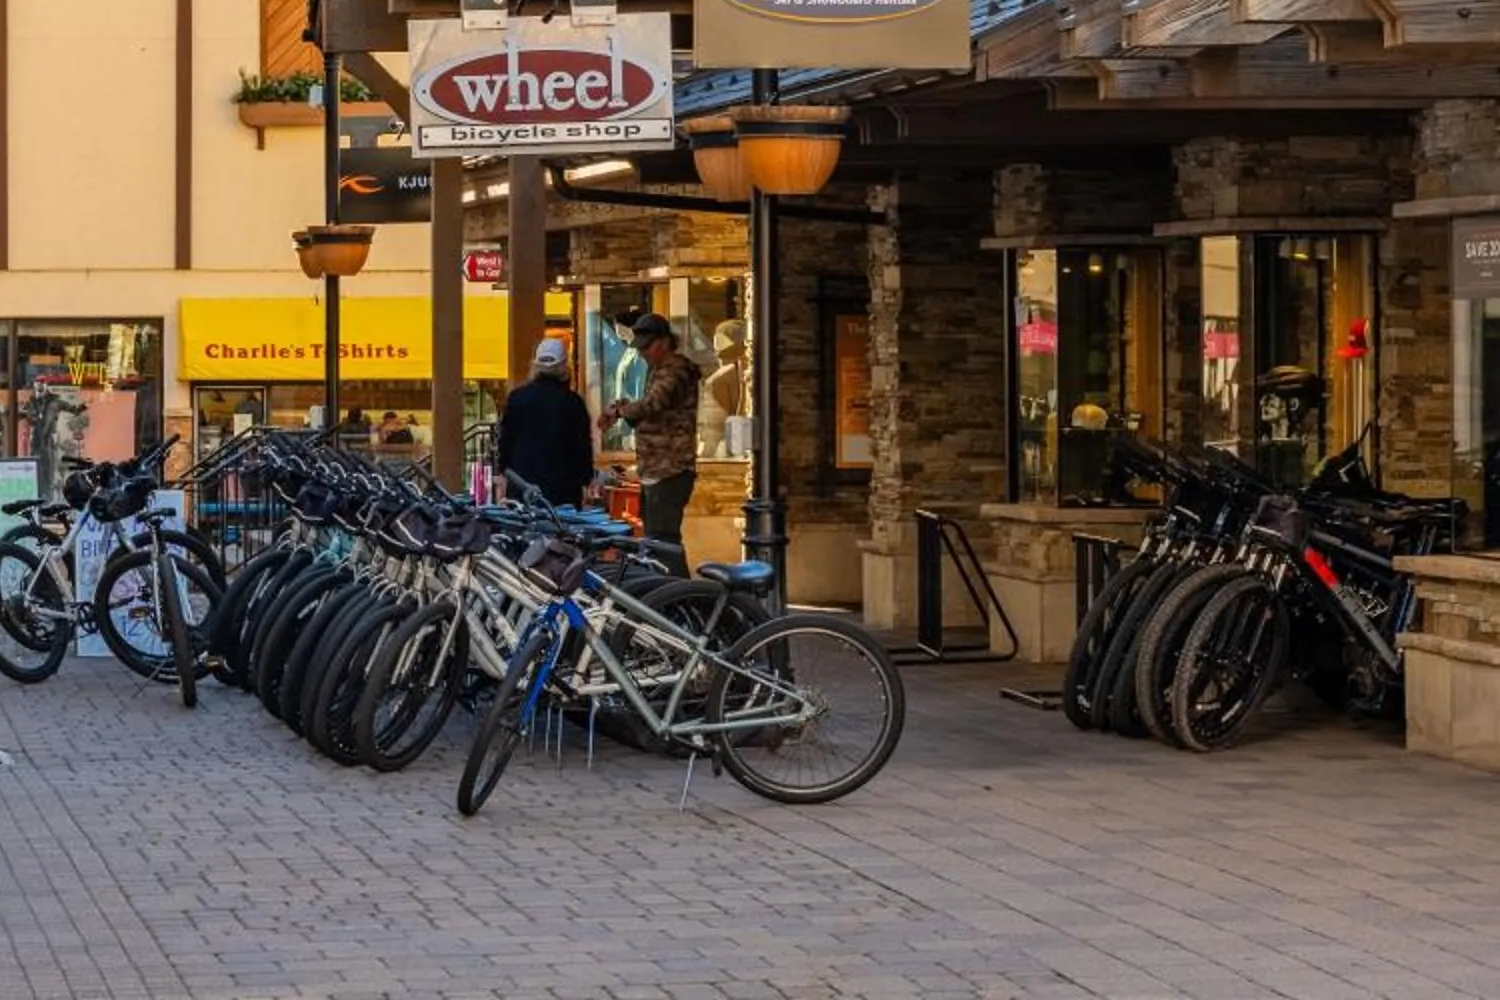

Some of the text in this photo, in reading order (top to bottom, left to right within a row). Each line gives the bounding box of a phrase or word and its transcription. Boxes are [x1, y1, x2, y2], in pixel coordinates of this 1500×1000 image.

[453, 32, 629, 113] wheel
[451, 124, 641, 141] bicycle shop
[398, 175, 434, 189] KJU
[310, 344, 409, 359] TShirts
